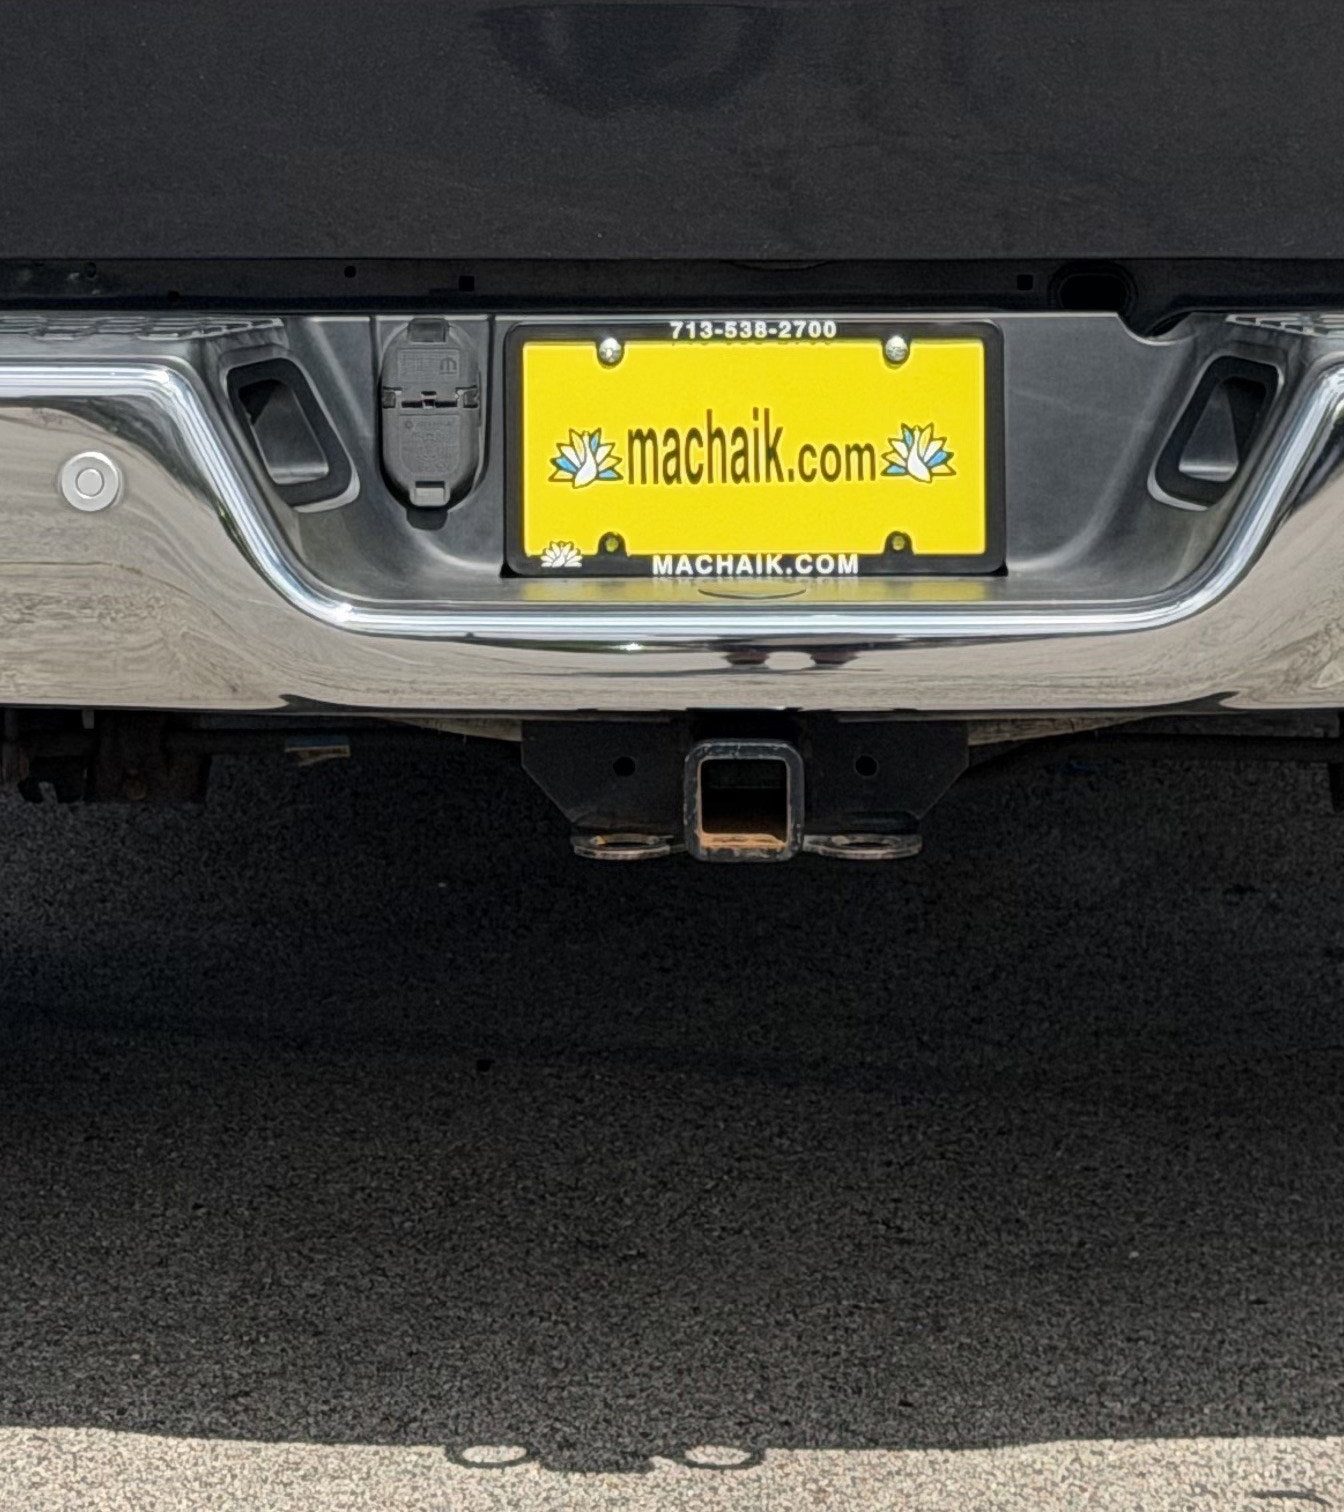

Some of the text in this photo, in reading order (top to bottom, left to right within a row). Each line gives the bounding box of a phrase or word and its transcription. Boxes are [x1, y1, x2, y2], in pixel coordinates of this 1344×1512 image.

[669, 320, 837, 339] 713-538-2700
[627, 407, 876, 484] machaik.com
[652, 554, 860, 575] MACHAIK.COM
